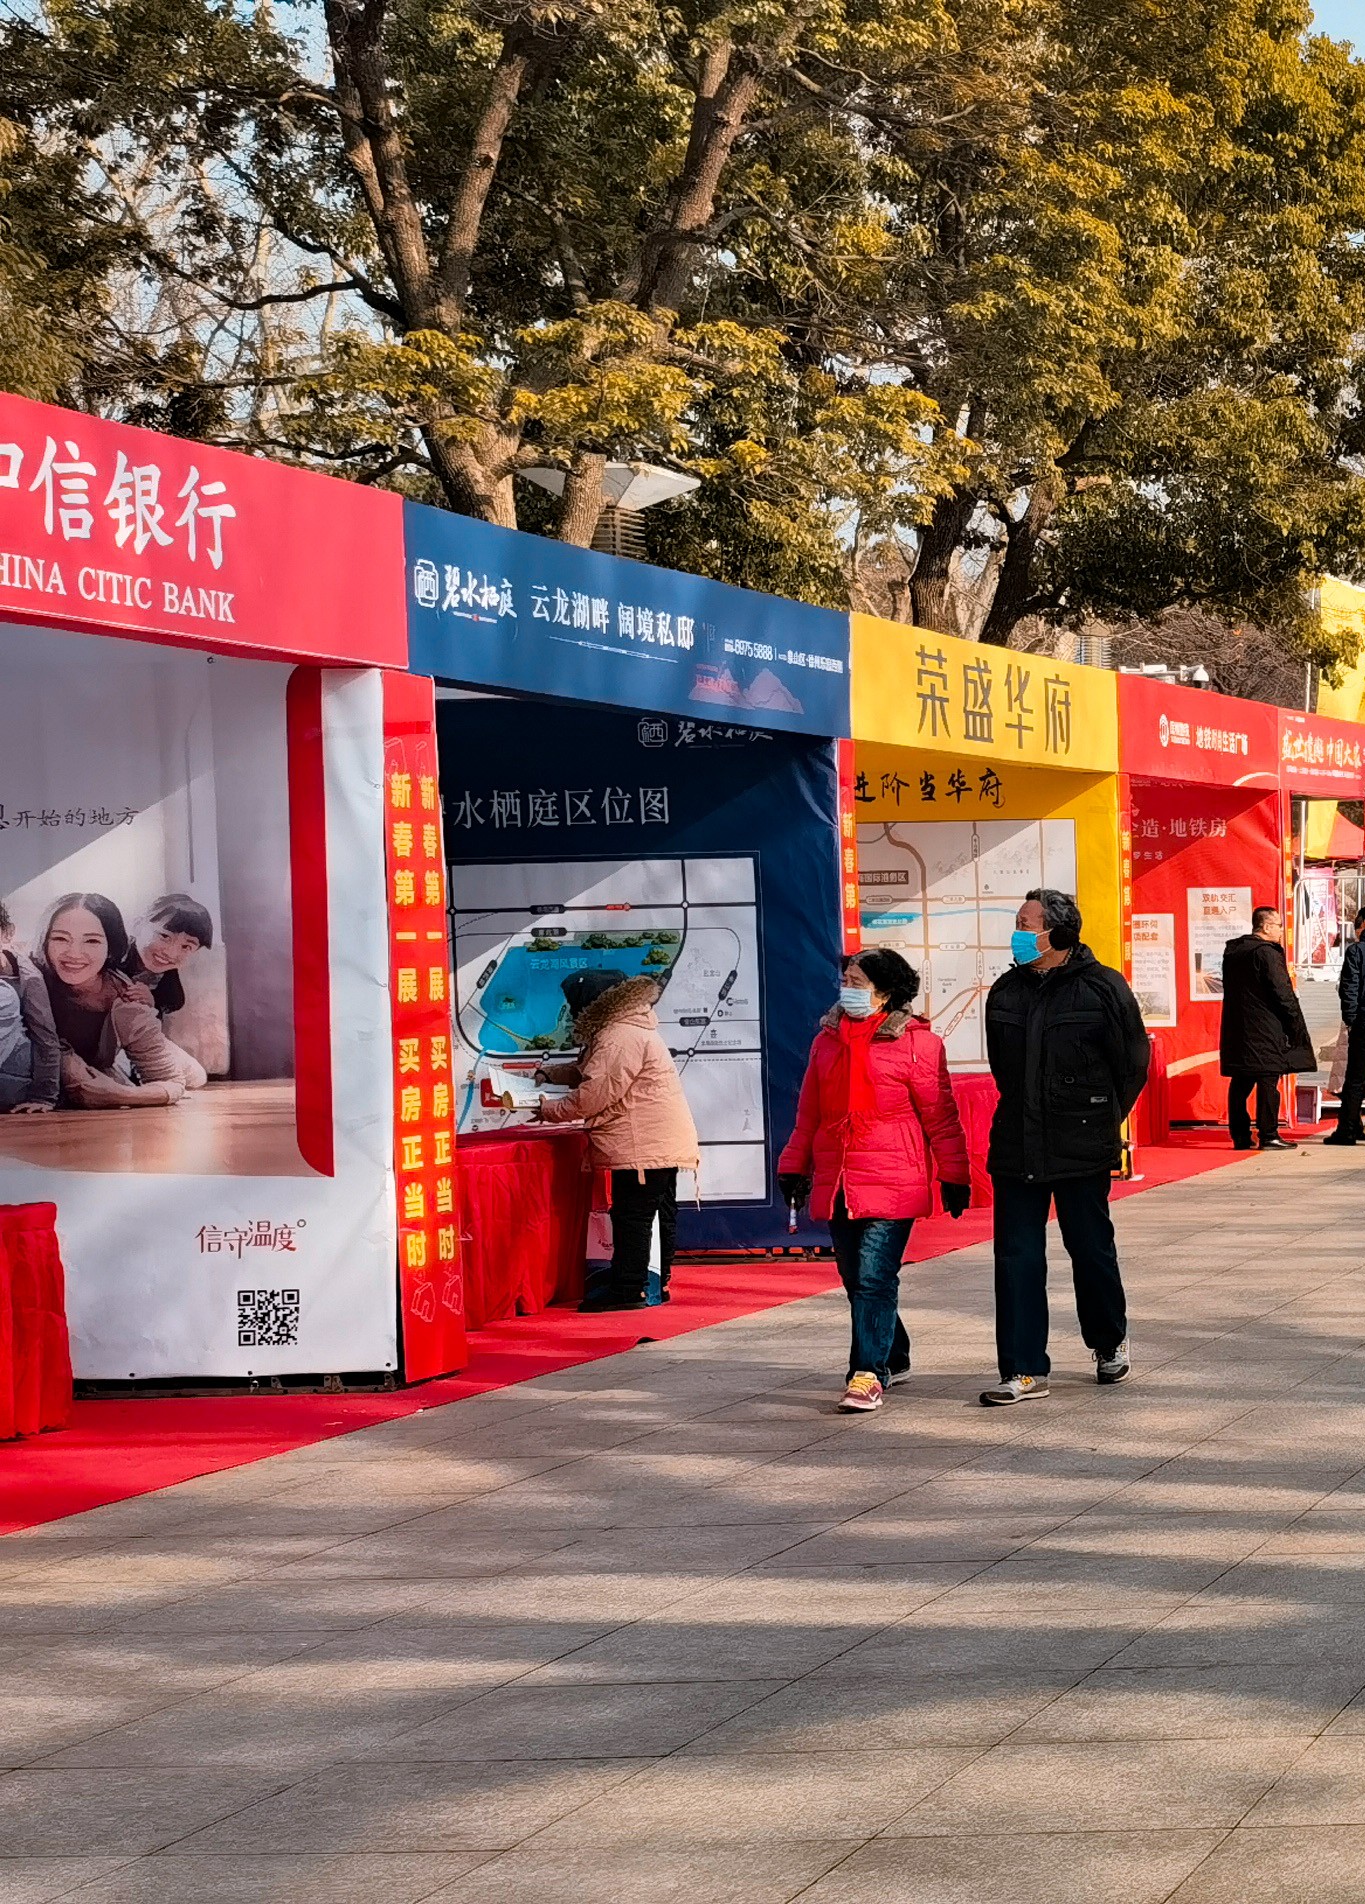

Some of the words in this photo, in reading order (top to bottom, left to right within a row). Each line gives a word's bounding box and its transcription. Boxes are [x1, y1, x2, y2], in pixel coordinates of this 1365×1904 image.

[77, 566, 152, 610] CITIC
[162, 581, 236, 624] BANK
[530, 582, 610, 636] 云龙湖畔
[617, 601, 696, 653] 阔境私邸
[915, 644, 1073, 755] 荣盛华府
[443, 785, 670, 830] 水栖庭区位图
[195, 1219, 298, 1260] 信守温度
